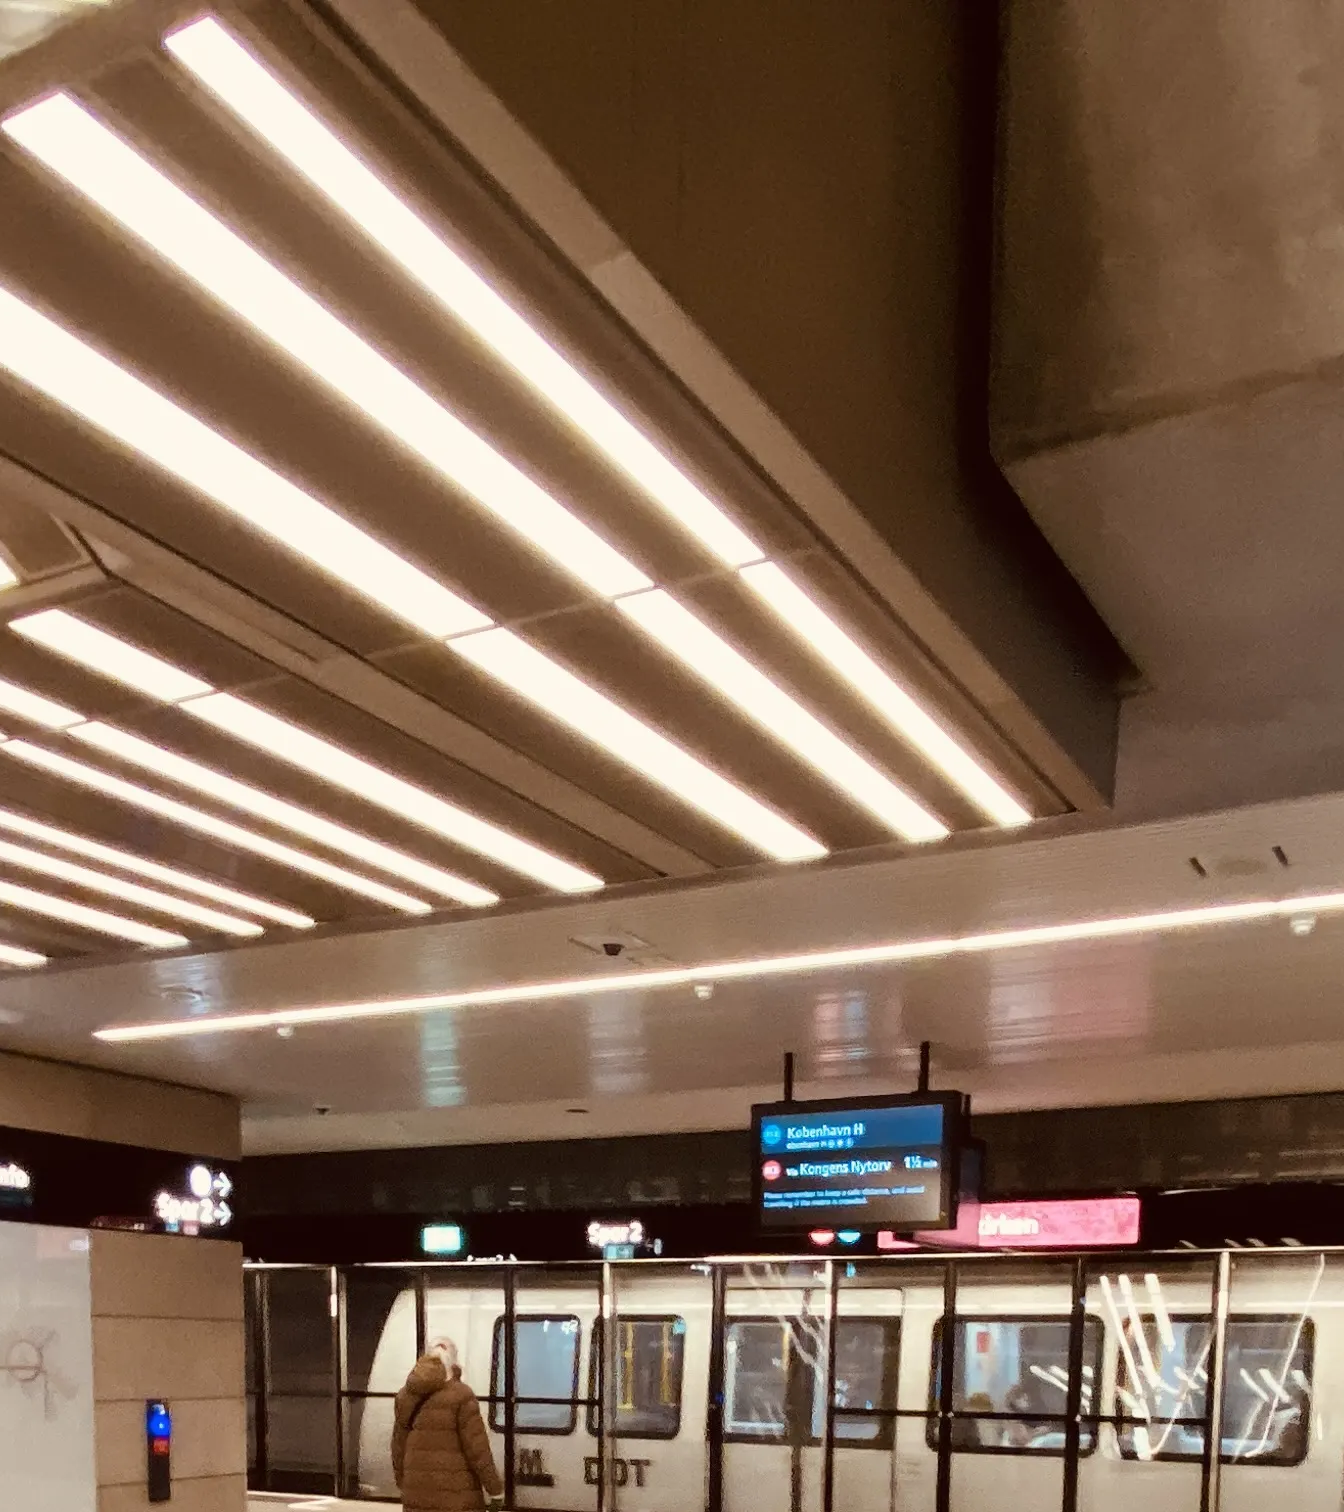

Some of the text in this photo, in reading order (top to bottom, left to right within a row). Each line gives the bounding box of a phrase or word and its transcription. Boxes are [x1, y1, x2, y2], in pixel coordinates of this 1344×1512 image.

[853, 1122, 865, 1136] H
[799, 1162, 848, 1178] Kongens
[850, 1159, 892, 1176] Nytorv
[200, 1198, 215, 1225] 2
[587, 1220, 644, 1248] Spor 2
